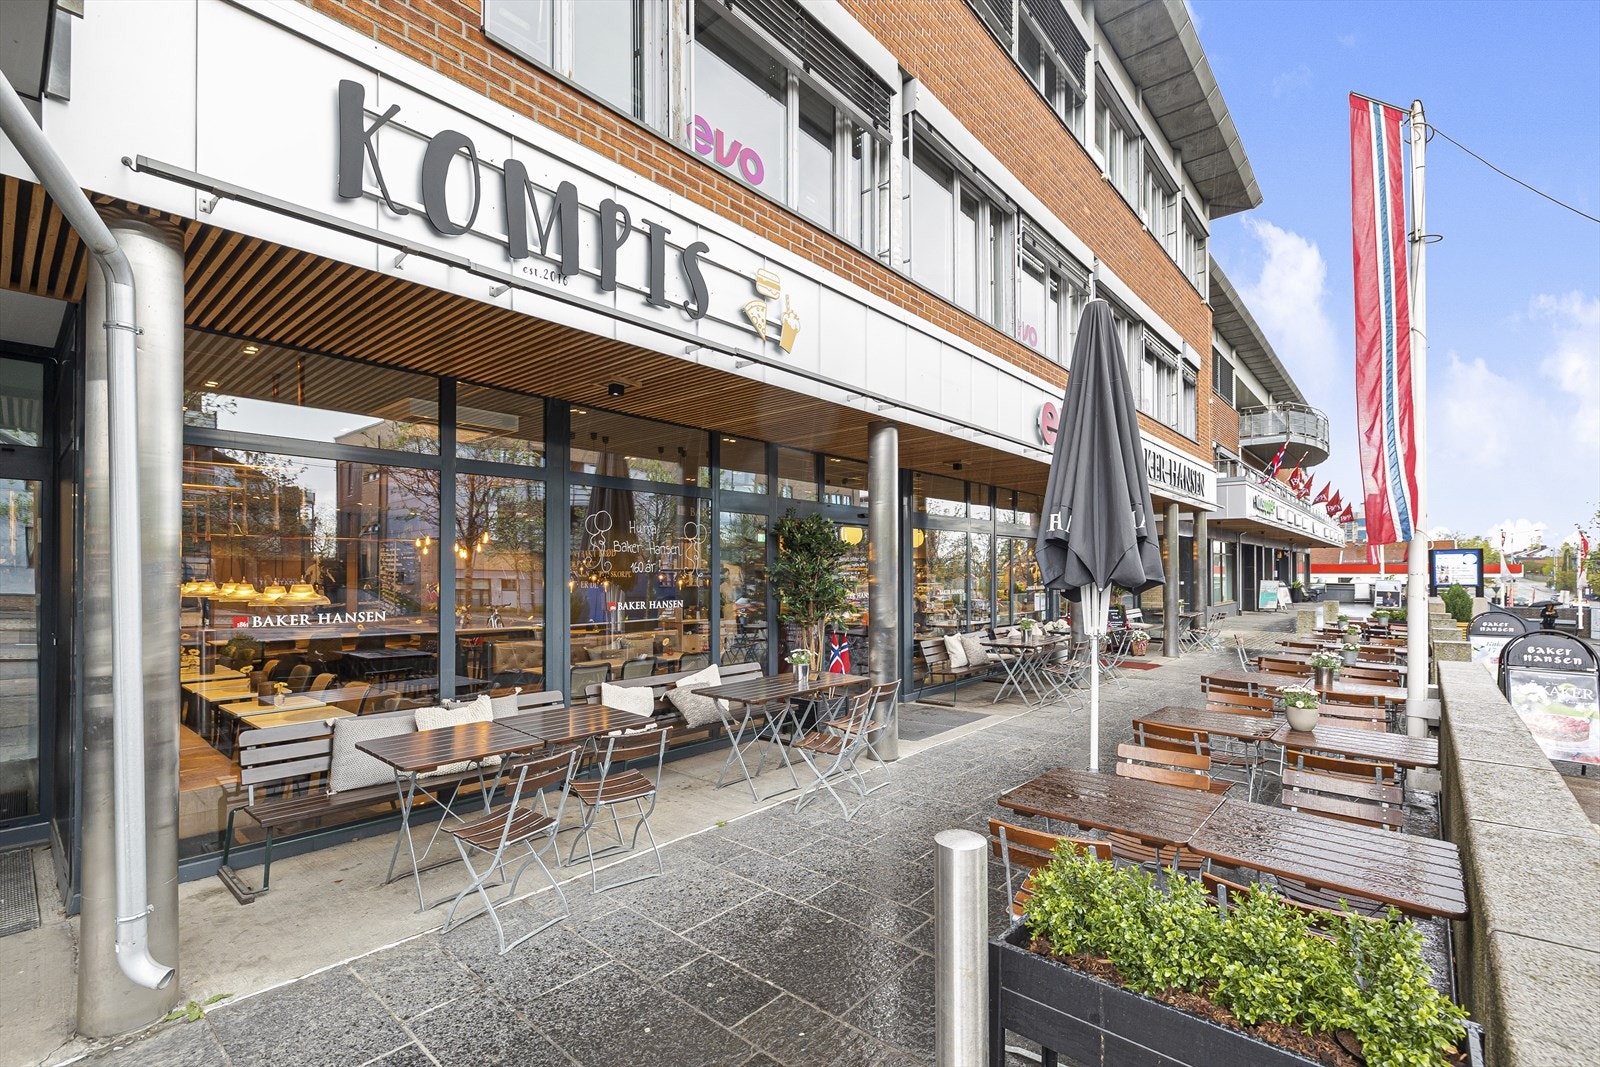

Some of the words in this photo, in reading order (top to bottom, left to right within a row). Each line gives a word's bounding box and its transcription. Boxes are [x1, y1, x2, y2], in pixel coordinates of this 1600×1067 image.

[687, 114, 765, 186] evo
[338, 79, 710, 319] KOMPIS
[523, 266, 568, 286] est.2016
[1144, 448, 1167, 483] KER
[1168, 459, 1205, 497] HANSEN
[613, 540, 642, 554] Baker
[648, 541, 683, 556] Hansen
[617, 601, 647, 611] BAKER
[649, 599, 684, 609] HANSEN
[252, 614, 311, 628] BAKER
[318, 611, 387, 625] HANSEN
